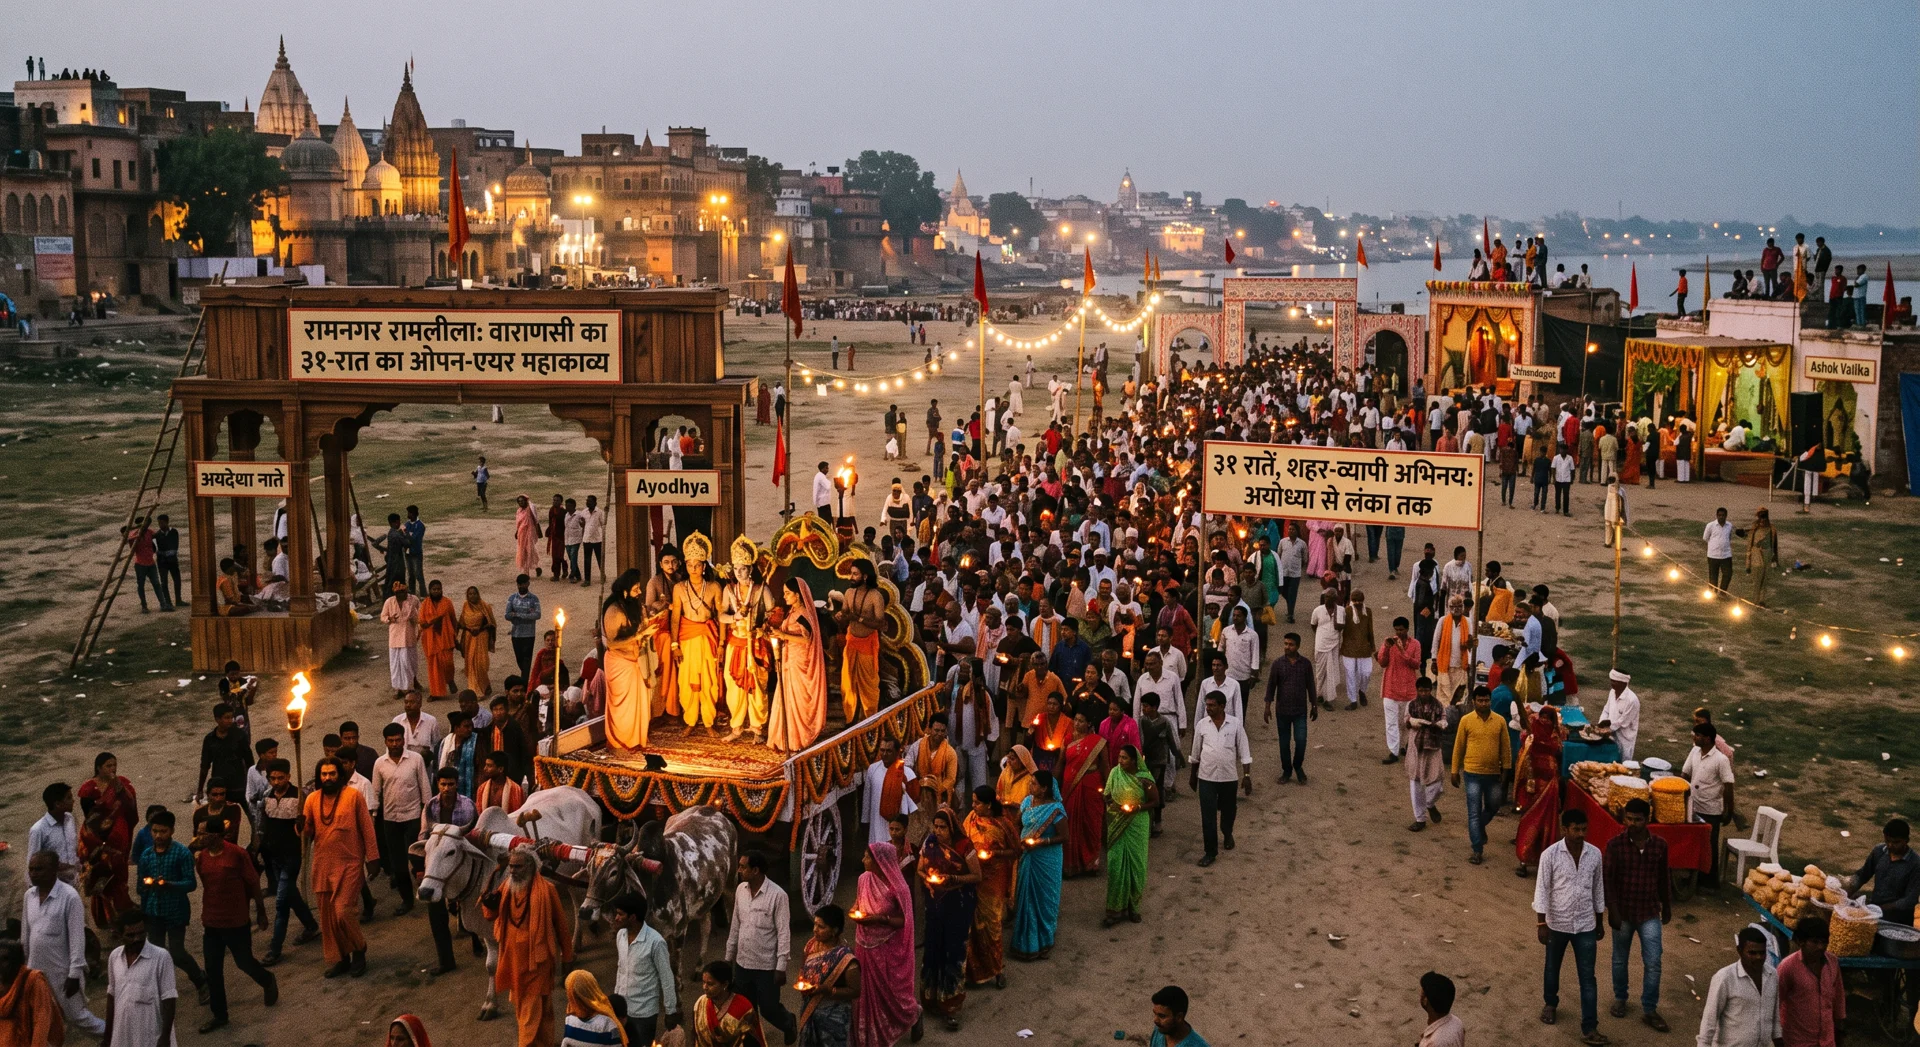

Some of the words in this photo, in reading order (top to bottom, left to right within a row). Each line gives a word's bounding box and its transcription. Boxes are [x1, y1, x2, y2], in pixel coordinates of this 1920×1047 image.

[304, 320, 382, 341] रामनगर
[489, 316, 575, 343] वाराणसी
[580, 322, 608, 342] का
[301, 350, 370, 373] ३१-रात
[375, 352, 404, 372] का
[410, 345, 516, 373] ओपन-एयर
[521, 352, 610, 376] महाकाव्य
[1811, 361, 1838, 374] Ashok
[1213, 454, 1238, 476] ३१
[1244, 450, 1281, 480] रातें,
[1287, 456, 1389, 482] शहर-व्यापी
[636, 478, 709, 498] Ayodhya
[1244, 481, 1316, 509] अयोध्या
[1321, 485, 1340, 511] से
[1345, 487, 1391, 514] लंका
[1396, 495, 1432, 516] तक
